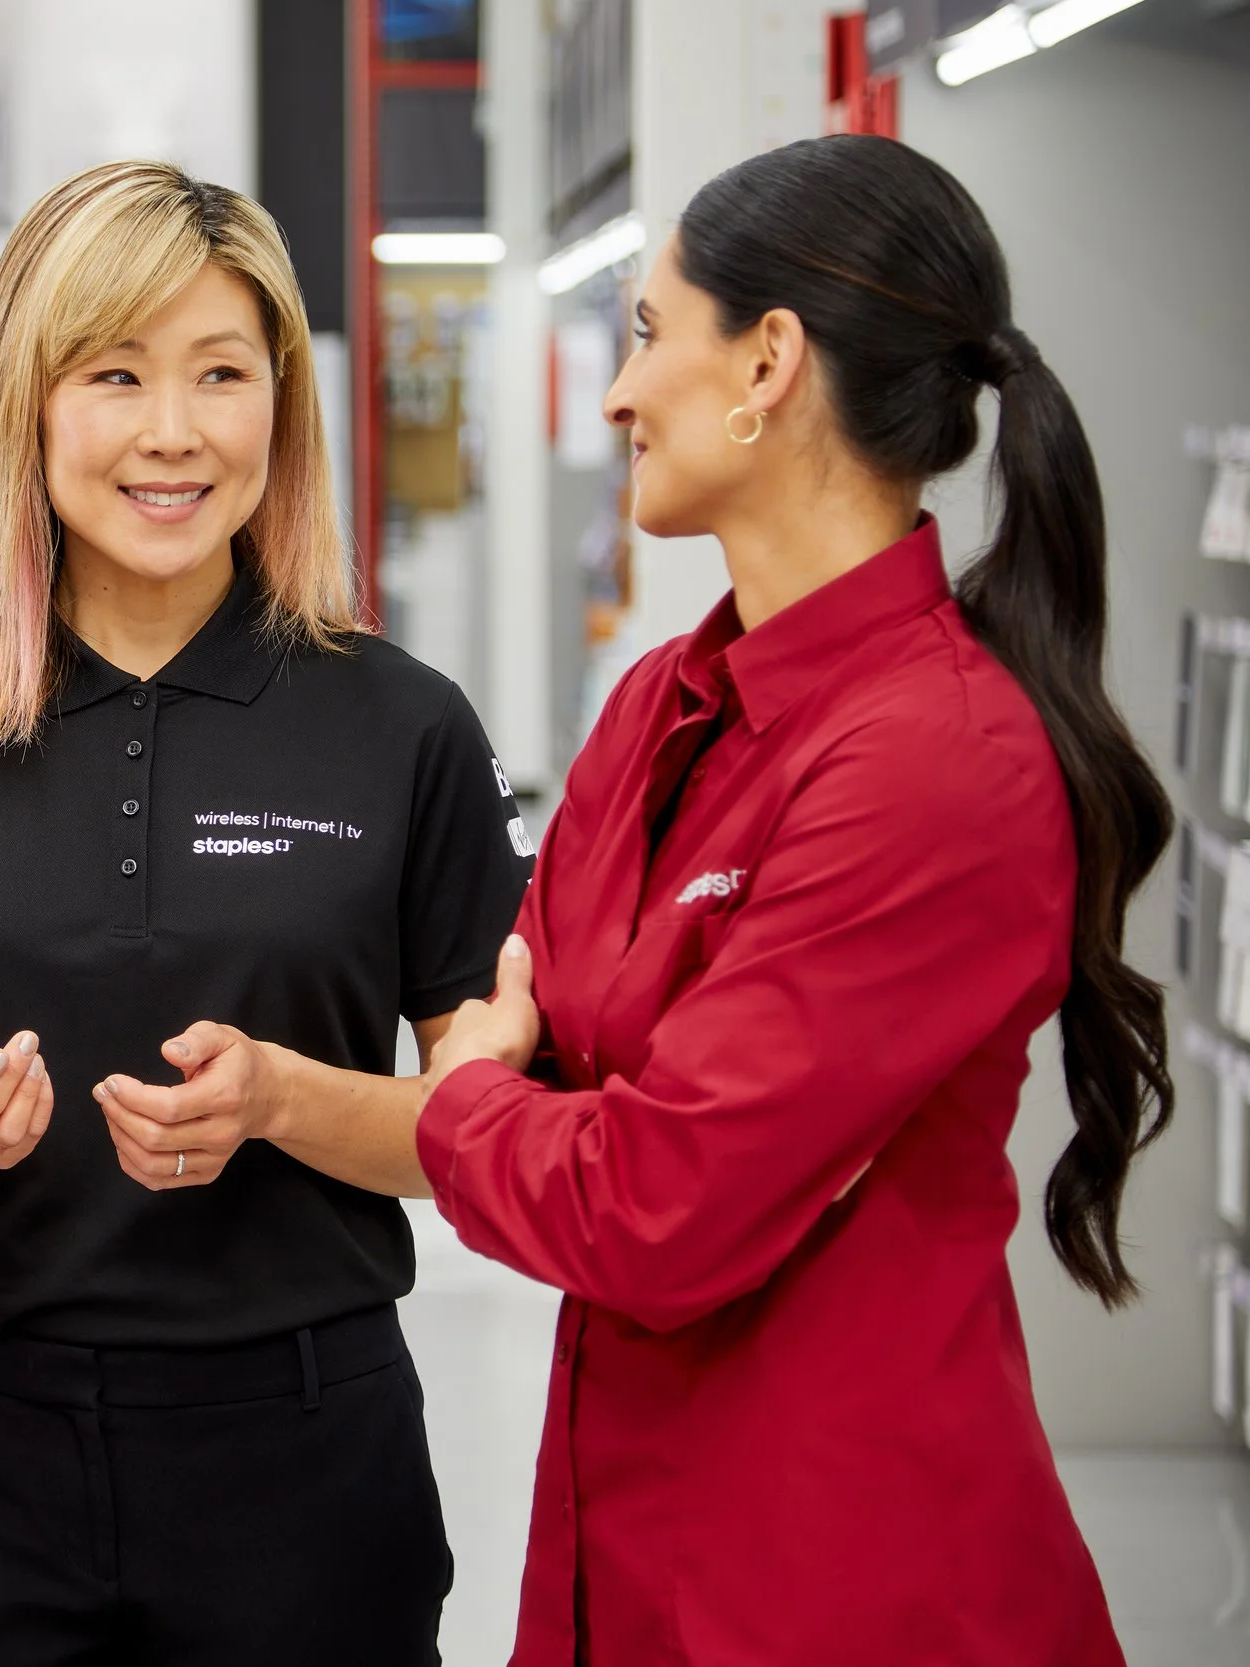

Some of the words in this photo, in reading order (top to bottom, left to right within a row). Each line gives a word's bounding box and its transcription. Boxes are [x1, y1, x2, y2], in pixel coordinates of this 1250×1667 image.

[195, 811, 260, 825] wireless
[271, 813, 336, 834] internet
[347, 825, 363, 839] tv
[192, 837, 275, 856] staples
